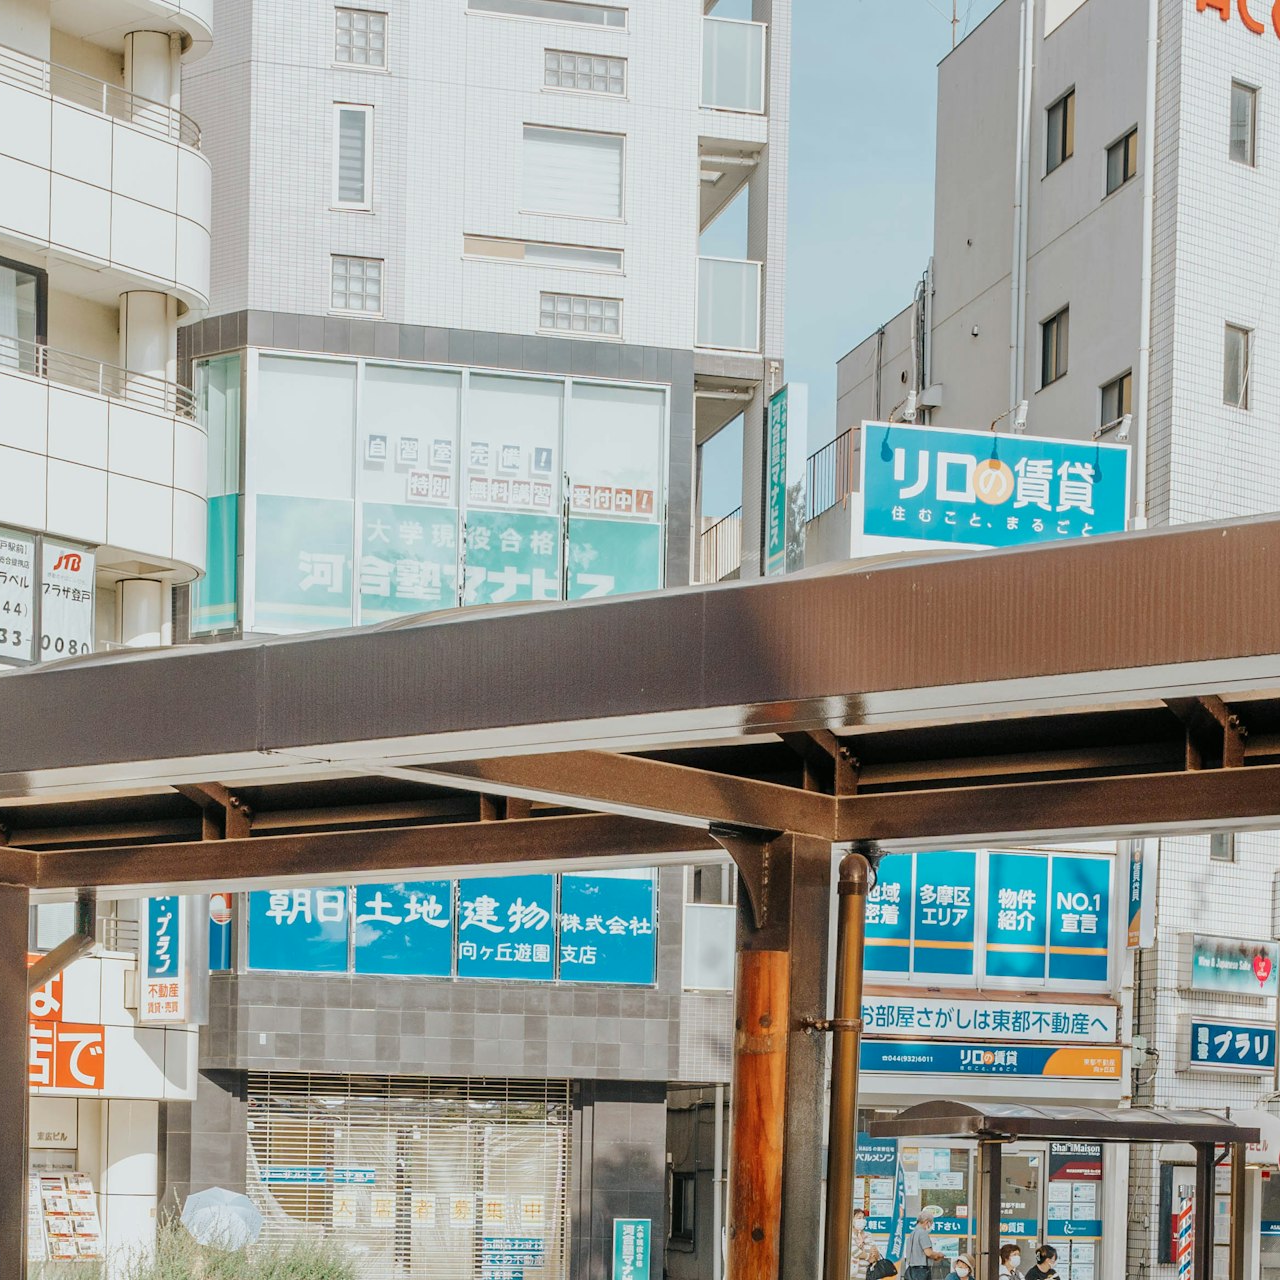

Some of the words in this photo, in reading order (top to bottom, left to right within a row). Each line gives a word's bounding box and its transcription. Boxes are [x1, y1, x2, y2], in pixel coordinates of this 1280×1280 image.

[893, 447, 1096, 516] リロの賃貸
[367, 519, 554, 557] 大学現役合格
[53, 553, 82, 572] JTB
[298, 550, 616, 603] 河合塾マナビス
[920, 884, 971, 907] 多摩区
[998, 888, 1037, 910] 物件
[1056, 891, 1101, 912] NO.1
[266, 888, 552, 934] 朝日土地建物
[561, 912, 653, 937] 株式会社
[922, 908, 968, 927] エリア
[997, 910, 1036, 932] 紹介
[1060, 913, 1098, 934] 宣言
[148, 983, 179, 998] 不動産
[147, 1001, 179, 1014] 賃貸・売買
[861, 1004, 1109, 1036] お部屋さがしは東都不動産へ
[1214, 1030, 1269, 1061] プラリ
[960, 1049, 1018, 1066] リロの賃貸
[1083, 1058, 1116, 1067] 東都不動産
[865, 1220, 886, 1231] 軽に
